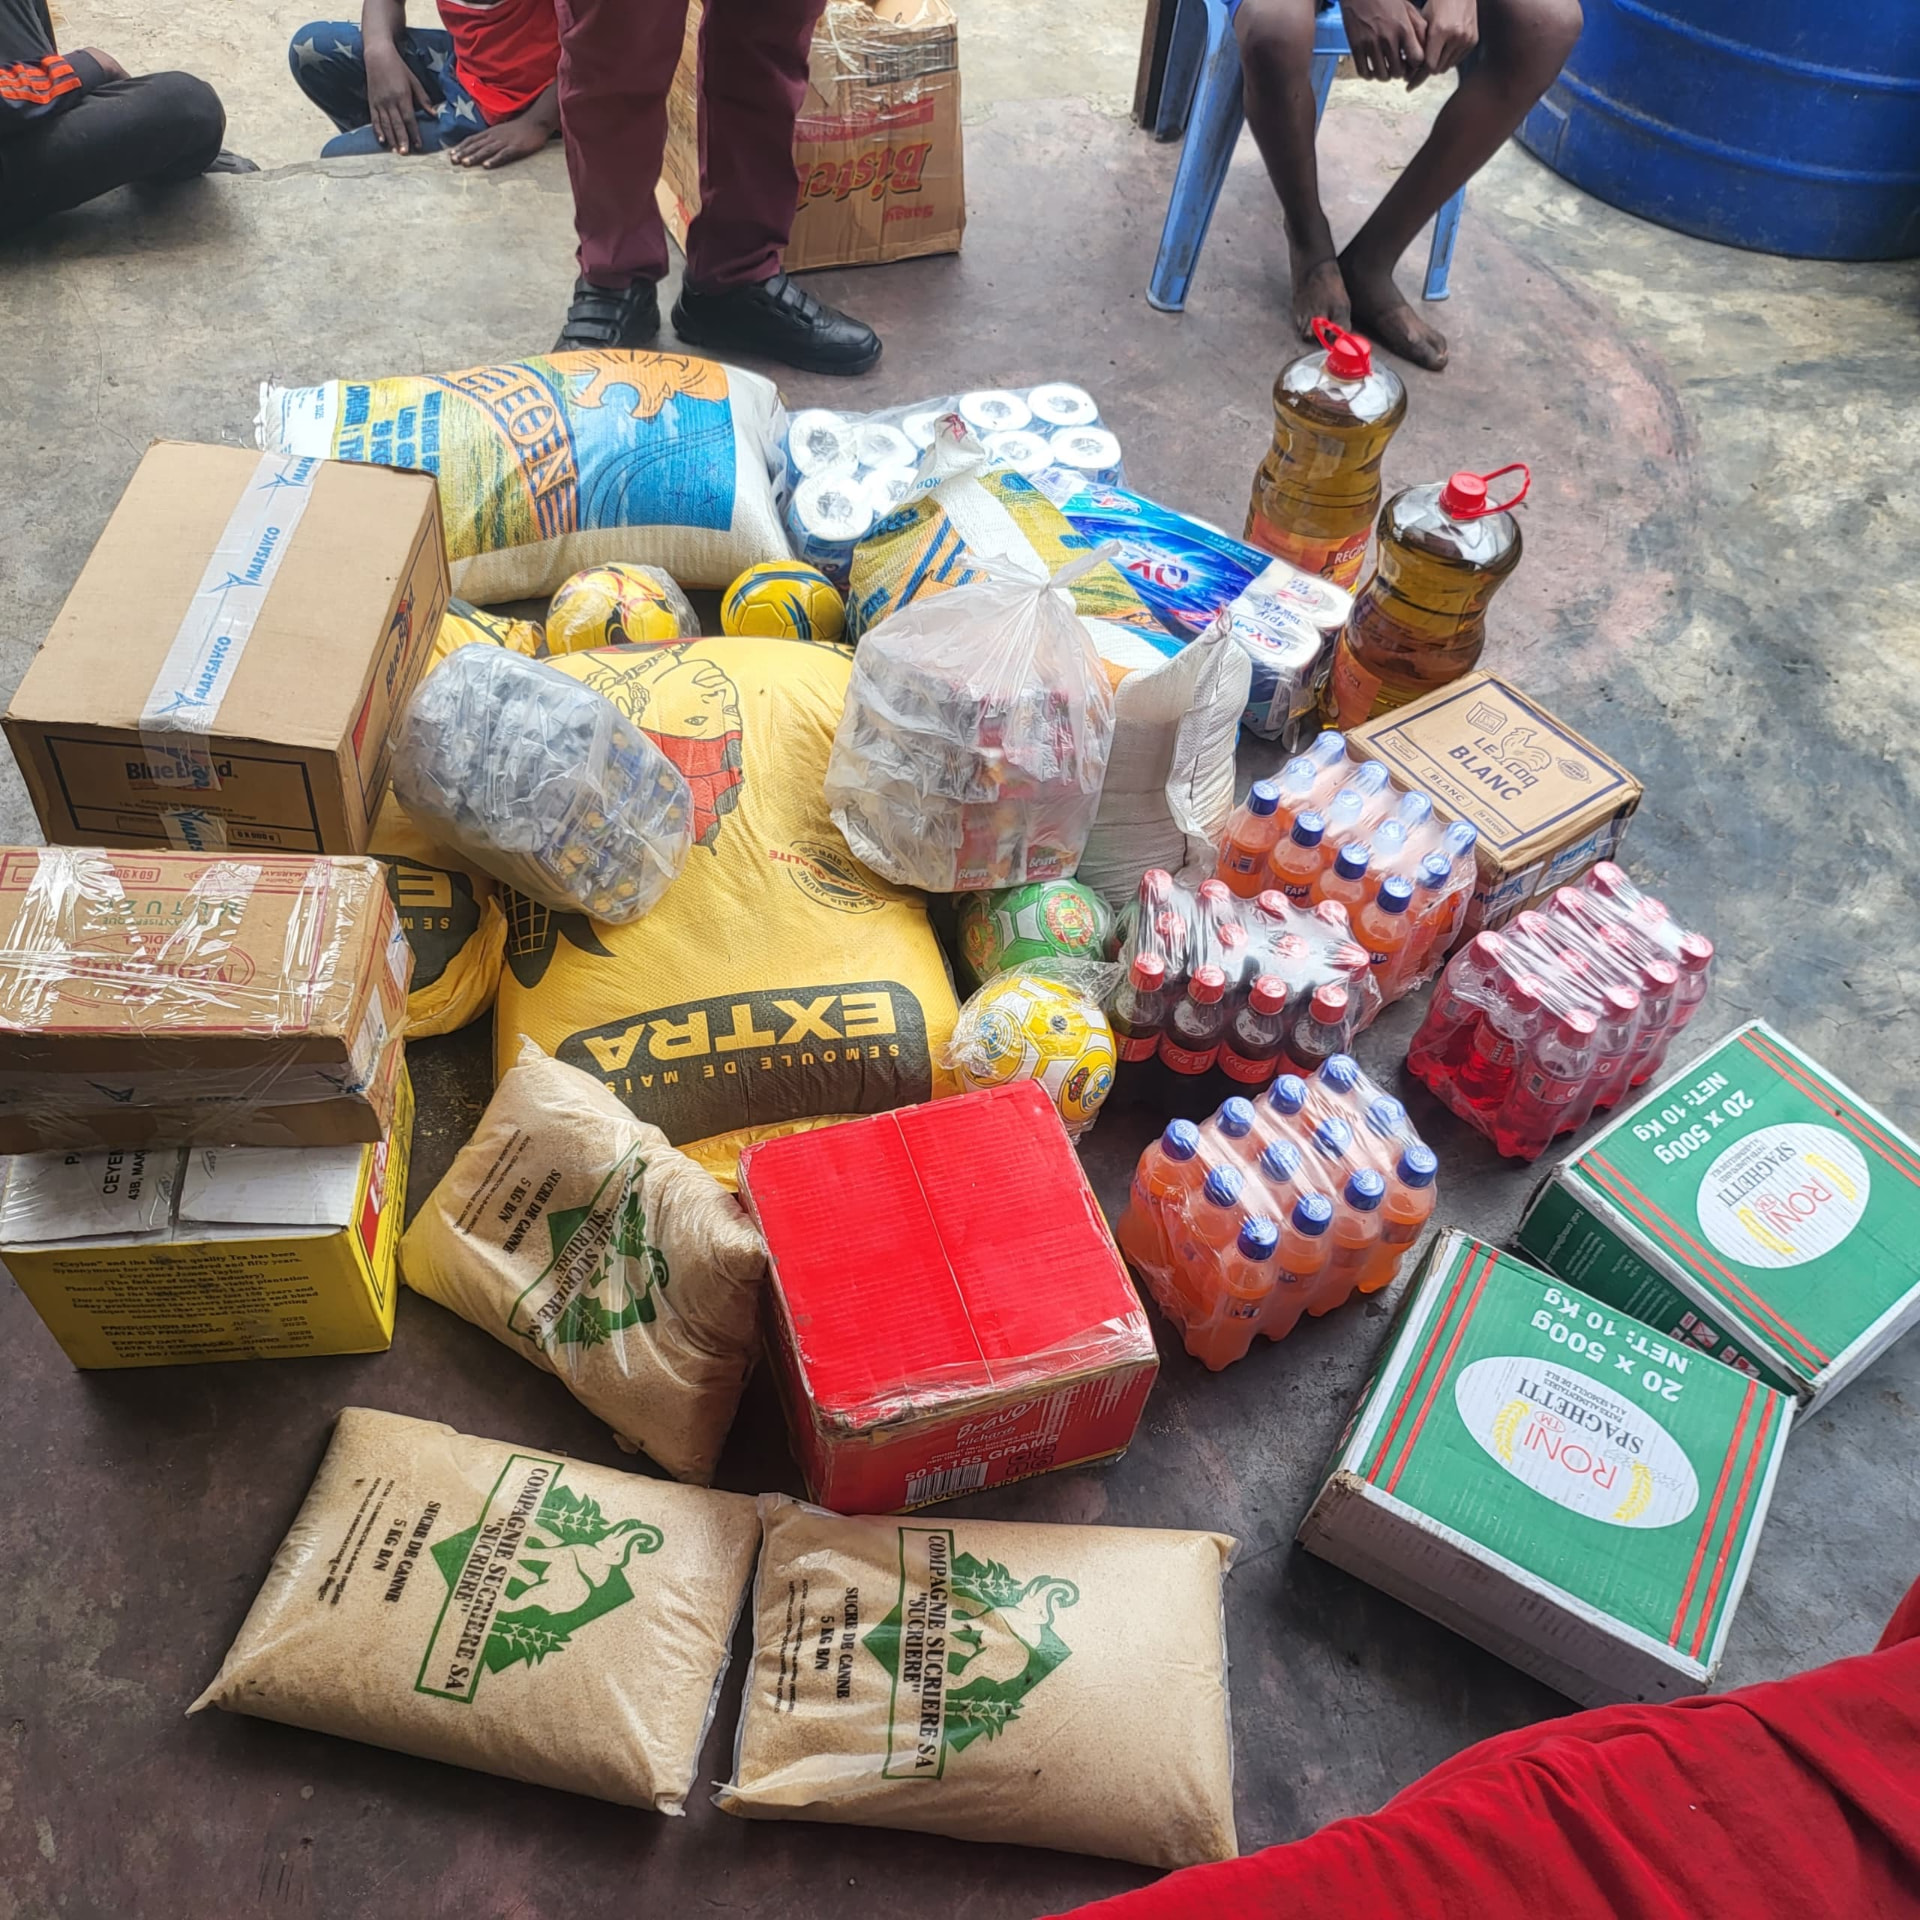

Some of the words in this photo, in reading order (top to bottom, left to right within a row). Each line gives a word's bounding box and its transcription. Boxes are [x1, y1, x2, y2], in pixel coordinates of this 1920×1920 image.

[246, 526, 281, 581] MARSAVCO
[194, 636, 232, 700] MARSAVCO
[1448, 745, 1523, 801] BLANC
[1474, 737, 1501, 757] LE
[1503, 763, 1540, 790] COQ
[1430, 774, 1466, 802] BLANC
[958, 868, 989, 880] Beurre
[584, 991, 897, 1073] EXTRA
[703, 1060, 737, 1078] DE
[759, 1043, 900, 1071] SEMOULE
[1683, 1071, 1729, 1107] NET:
[1722, 1089, 1755, 1118] 20
[1632, 1118, 1667, 1142] Kg
[1661, 1104, 1687, 1125] 10
[1653, 1123, 1712, 1165] 500g
[128, 1178, 141, 1201] 43B,
[518, 1175, 533, 1187] 5
[1716, 1141, 1797, 1208] SPAGHETTI
[508, 1184, 527, 1203] KG
[1766, 1176, 1833, 1235] RONI
[495, 1200, 518, 1224] B/N
[553, 1207, 615, 1284] "SUCRIERE"
[537, 1247, 600, 1323] SUCRIERE
[1543, 1287, 1581, 1319] Kg
[1530, 1309, 1607, 1364] 500g
[1585, 1311, 1617, 1336] 10
[1613, 1353, 1636, 1375] x
[1625, 1330, 1690, 1375] NET:
[1571, 1384, 1610, 1407] SEMOULE
[1641, 1370, 1684, 1403] 20
[953, 1400, 1034, 1440] Bravo
[1516, 1376, 1645, 1456] SPAGHETTI
[956, 1424, 1016, 1449] Pilchards
[903, 1467, 928, 1482] 50
[950, 1452, 983, 1470] 155
[986, 1432, 1061, 1461] GRAMS
[1523, 1422, 1618, 1490] RONI
[394, 1519, 407, 1527] 5
[413, 1501, 442, 1538] SUCRE
[500, 1468, 549, 1563] COMPAGNIE
[385, 1529, 402, 1546] KG
[373, 1548, 394, 1571] B/N
[454, 1517, 507, 1613] "SUCRIERE"
[385, 1560, 413, 1603] CANNE
[926, 1534, 950, 1631] COMPAGNIE
[456, 1562, 508, 1661] SUCRIERE
[819, 1615, 834, 1624] 5
[843, 1586, 860, 1631] SUCRE
[818, 1626, 834, 1644] KG
[840, 1632, 856, 1650] DE
[903, 1591, 929, 1694] "SUCRIERE"
[445, 1661, 469, 1691] SA
[813, 1647, 830, 1670] B/N
[835, 1654, 855, 1699] CANNE
[920, 1635, 946, 1738] SUCRIERE
[914, 1743, 937, 1769] SA
